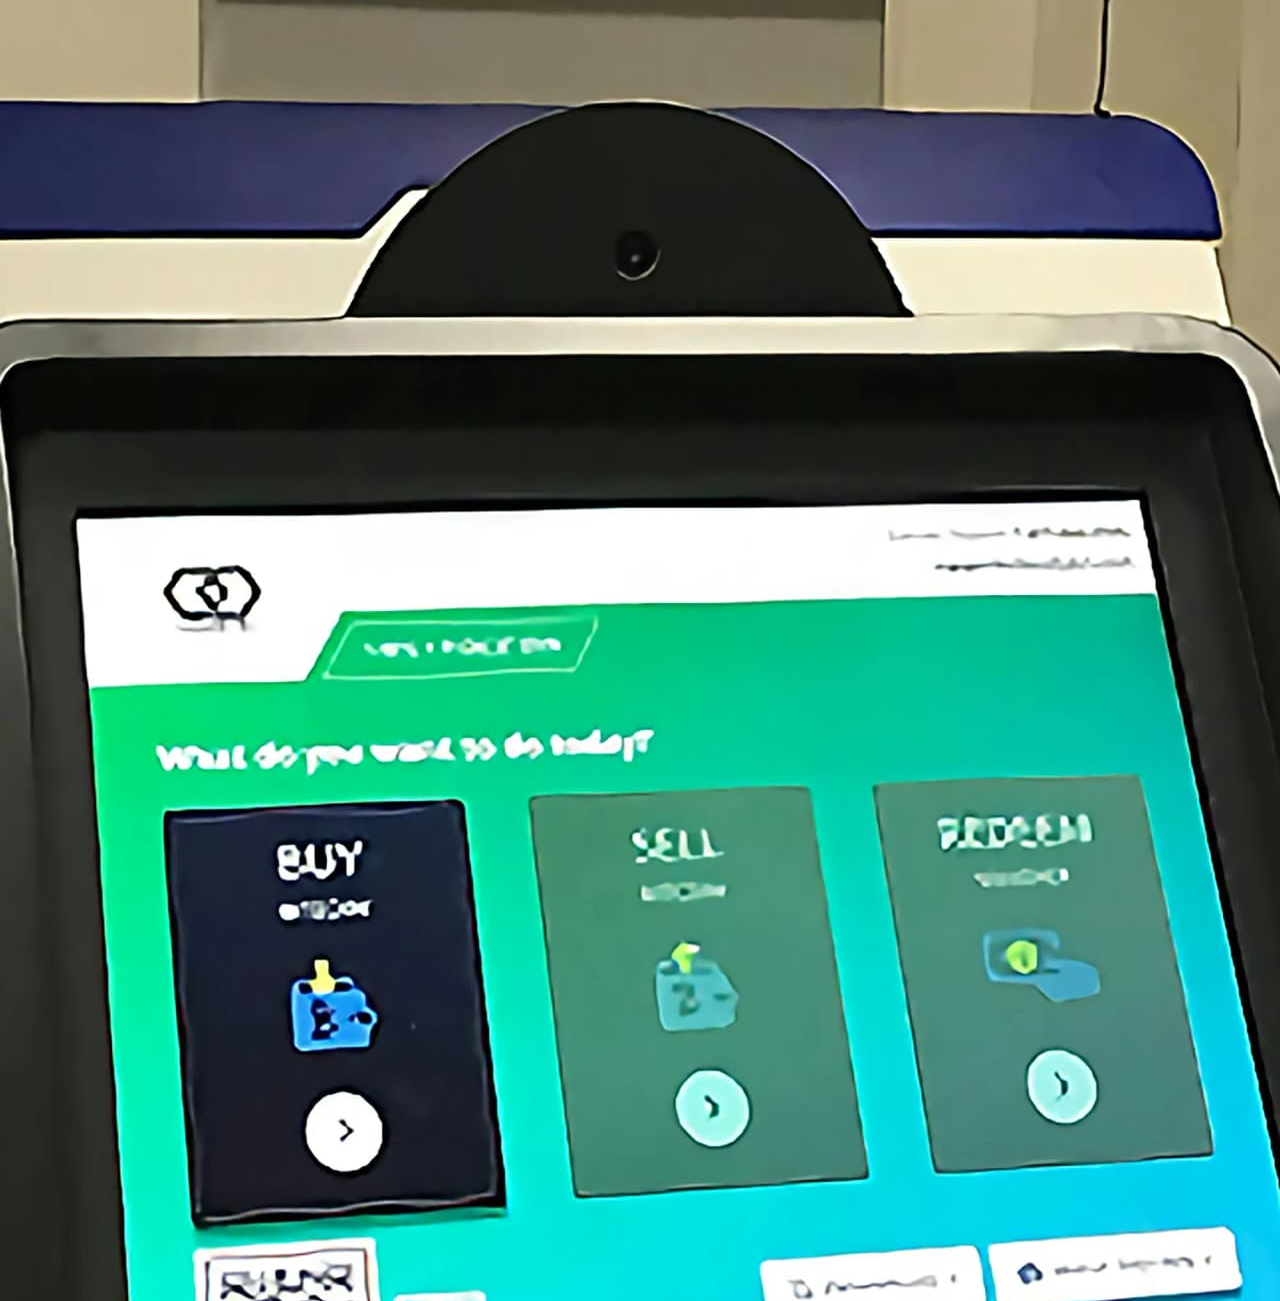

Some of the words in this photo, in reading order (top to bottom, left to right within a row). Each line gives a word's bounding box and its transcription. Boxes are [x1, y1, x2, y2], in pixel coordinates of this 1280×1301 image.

[157, 745, 247, 772] What
[631, 827, 724, 863] SELL
[937, 813, 1093, 850] REDEEM
[277, 840, 363, 881] BUY
